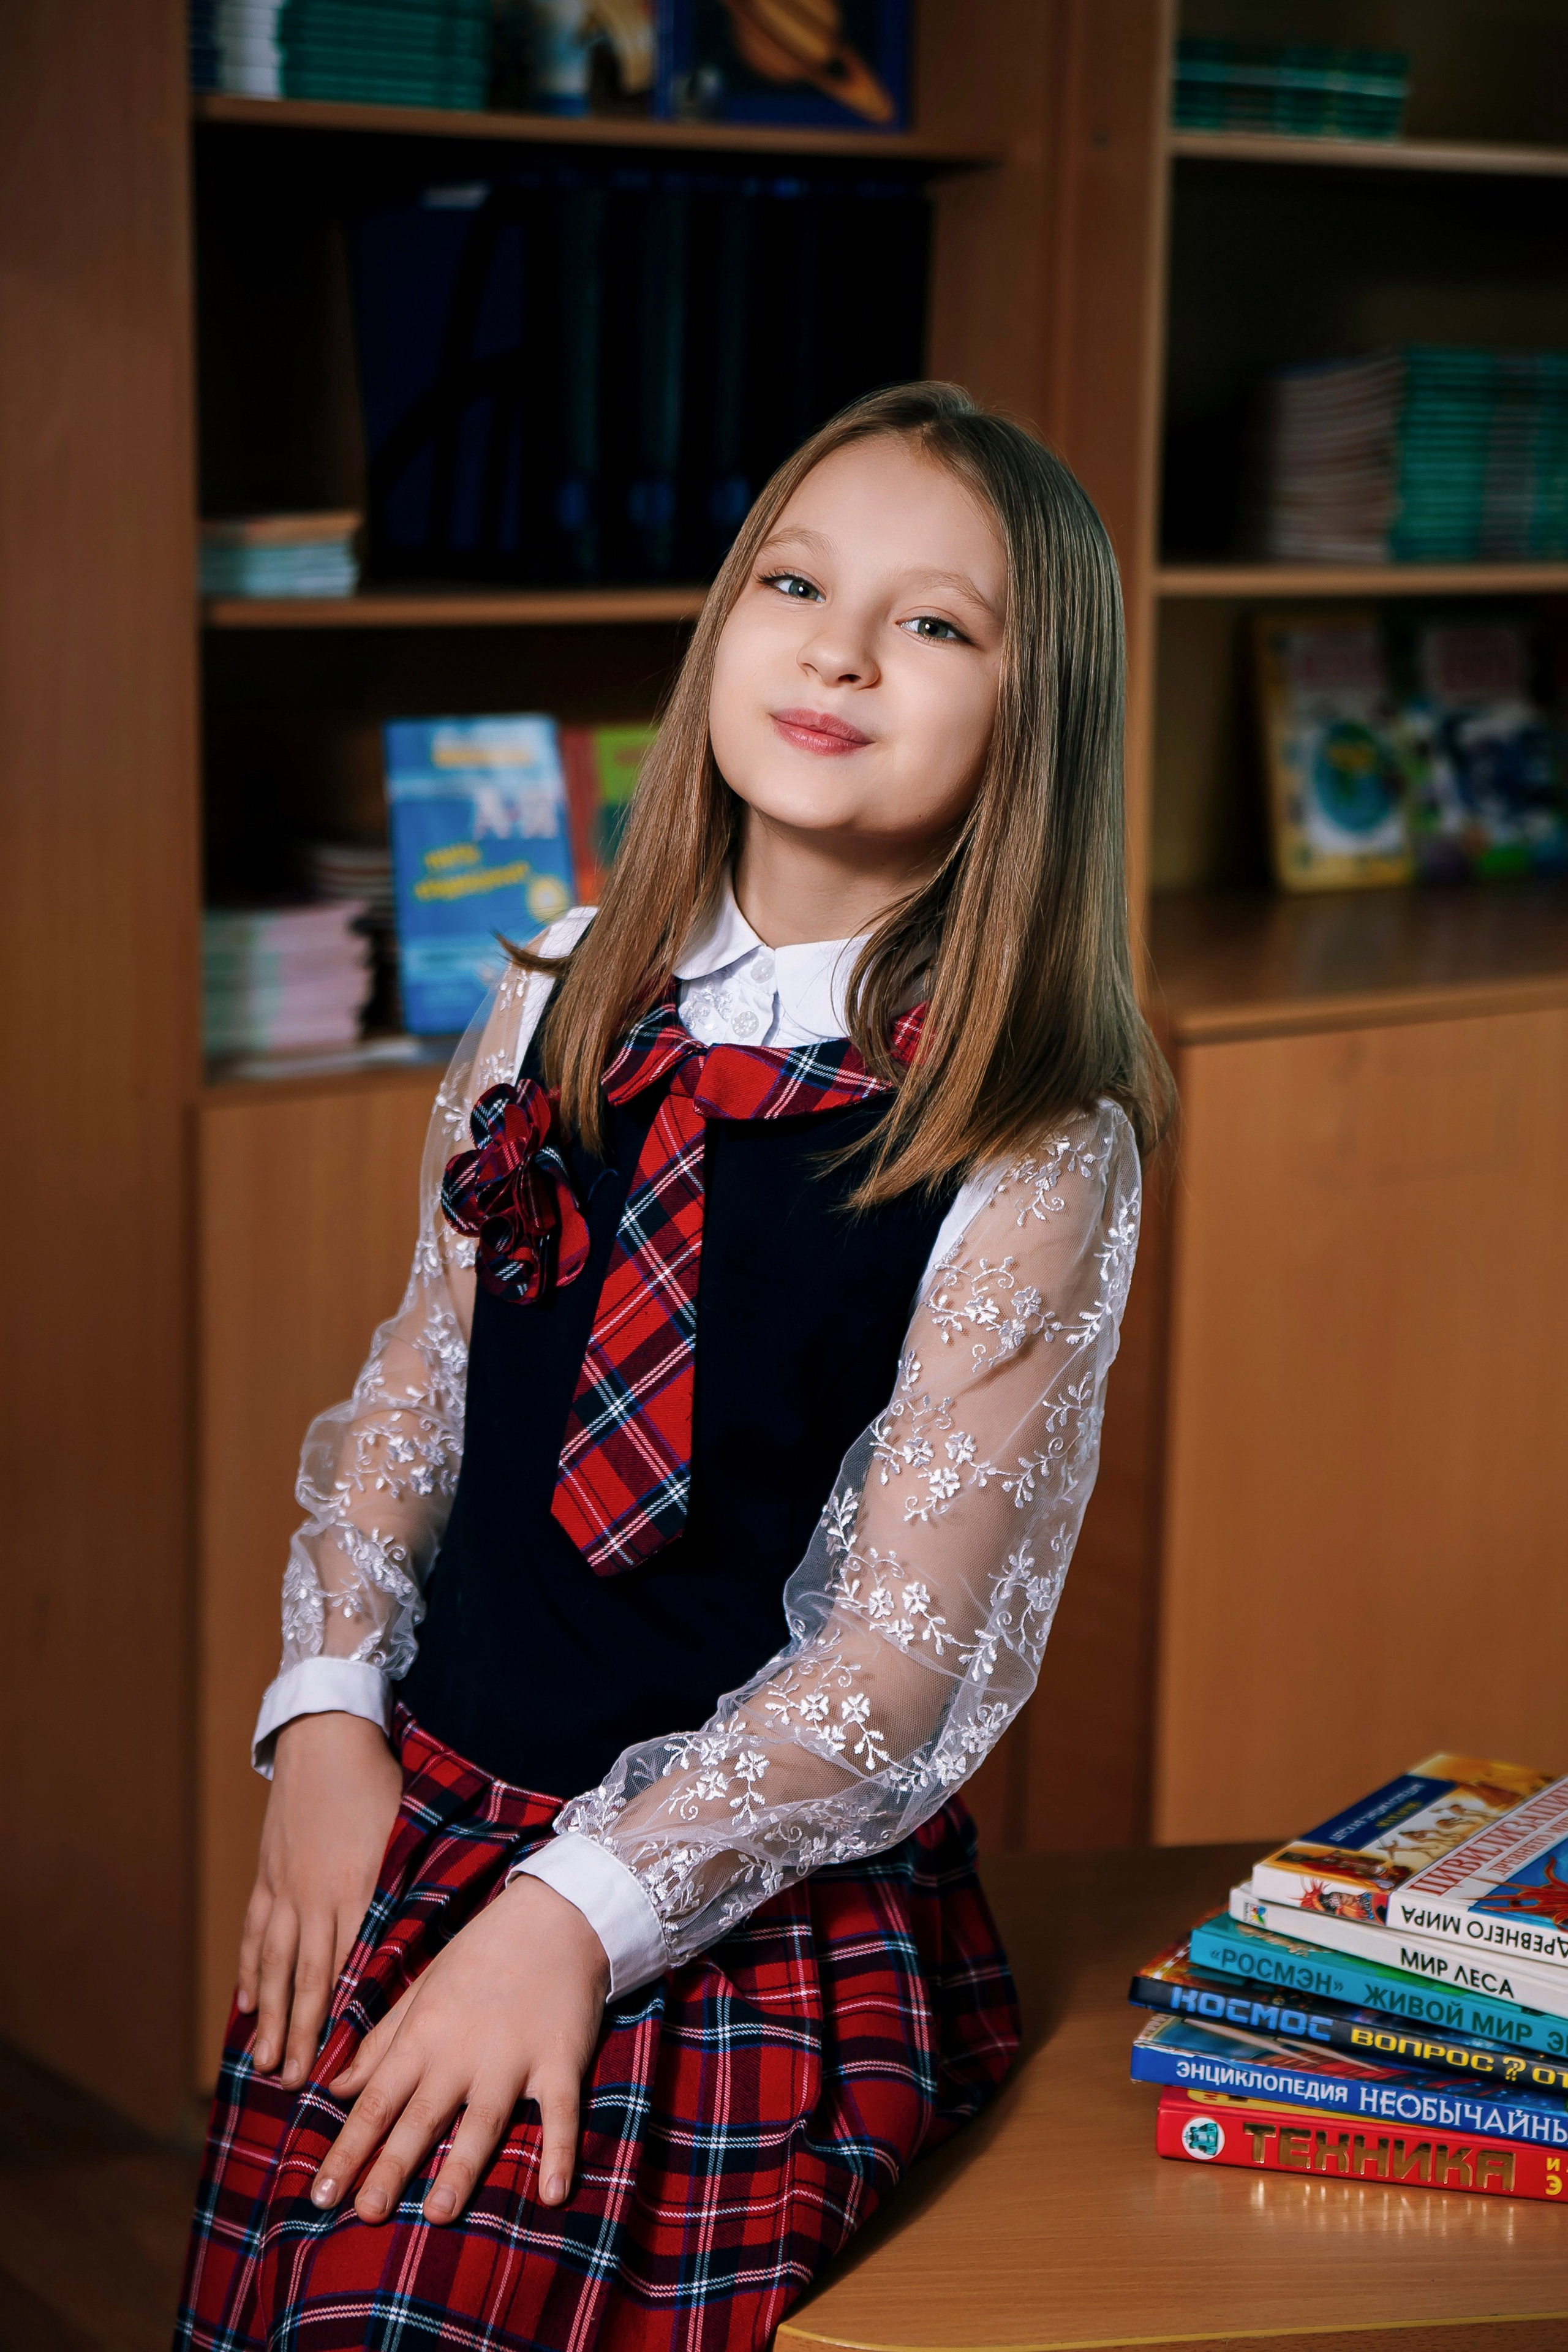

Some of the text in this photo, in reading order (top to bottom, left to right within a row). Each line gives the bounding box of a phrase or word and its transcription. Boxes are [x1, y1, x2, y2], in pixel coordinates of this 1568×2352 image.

[1401, 1905, 1461, 1934] МИРА
[1210, 1948, 1568, 2054] «РОСМЭН» ЖИВОЙ МИР Э
[1401, 1948, 1514, 1999] МИР ЛЕСА
[1170, 1986, 1333, 2041] КОСМОС
[1351, 2029, 1494, 2071] ВОПРОС
[1176, 2061, 1348, 2103] ЭНЦИКЛОПЕДИЯ
[1243, 2122, 1516, 2192] ТЕХНИКА
